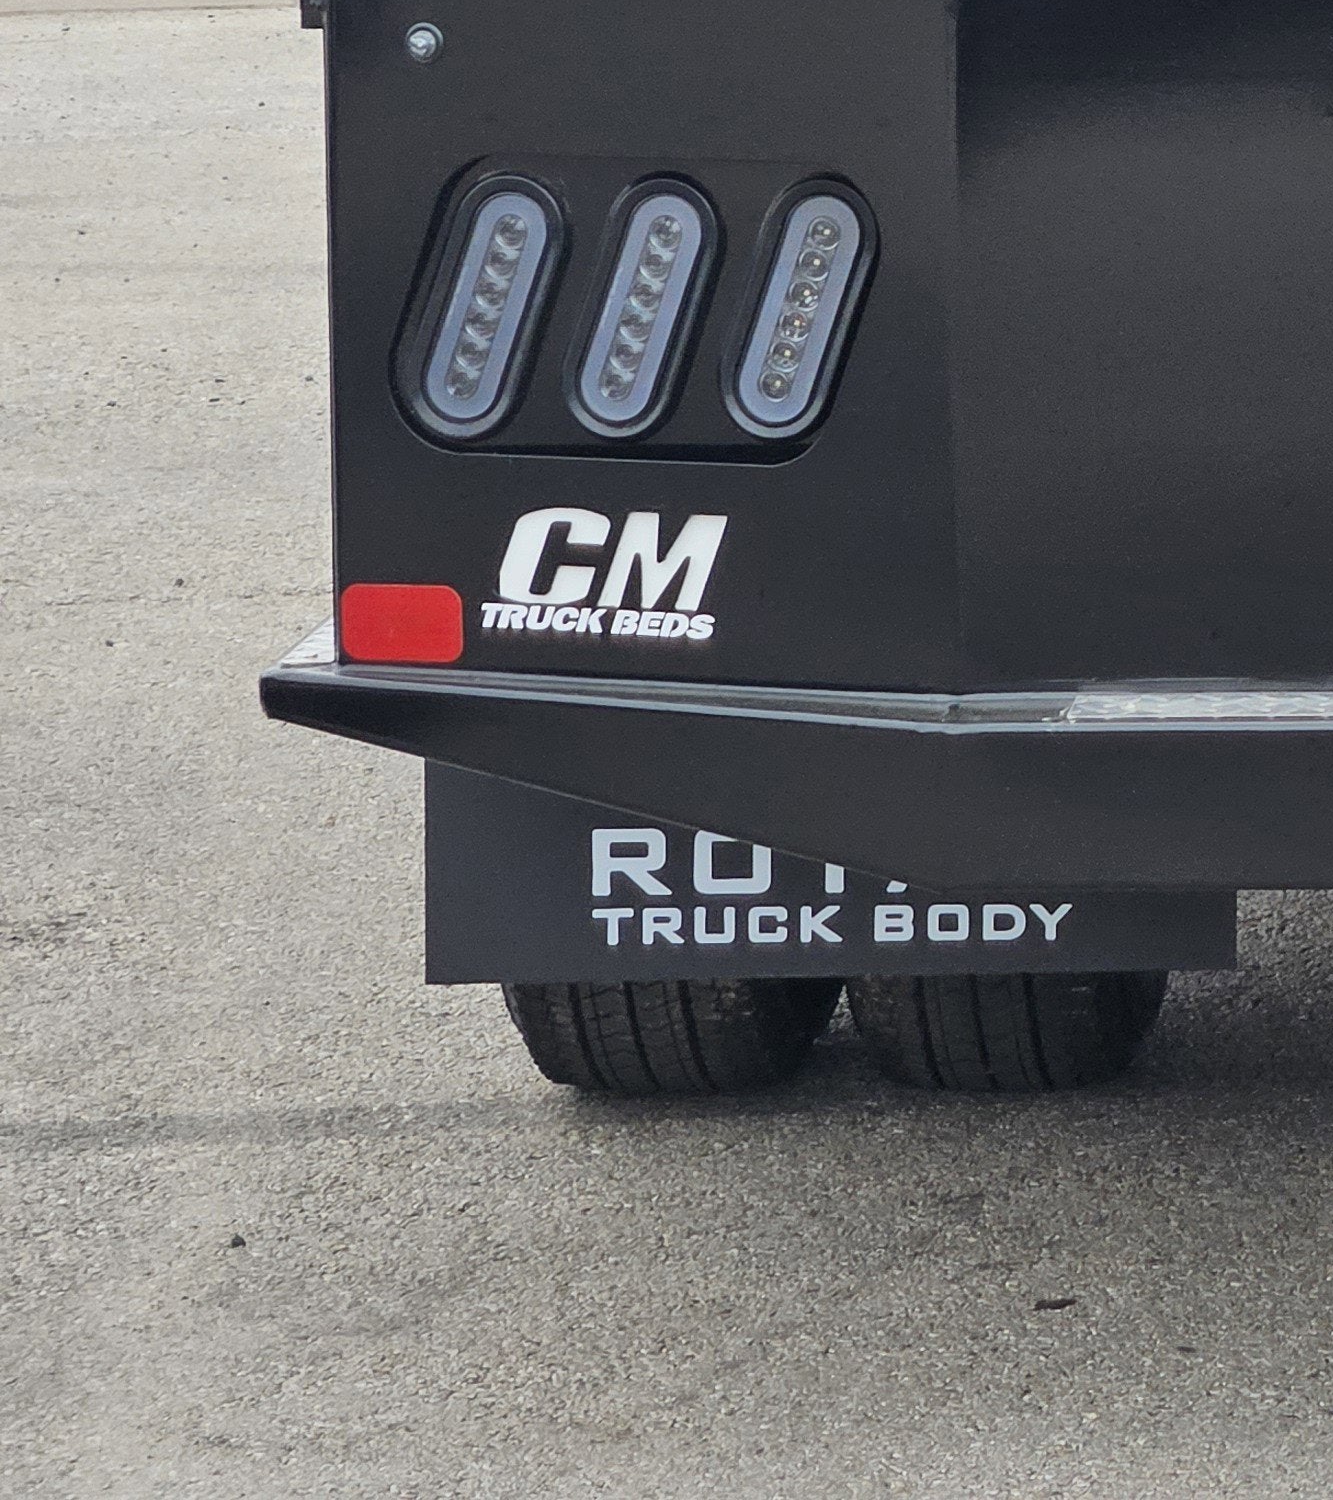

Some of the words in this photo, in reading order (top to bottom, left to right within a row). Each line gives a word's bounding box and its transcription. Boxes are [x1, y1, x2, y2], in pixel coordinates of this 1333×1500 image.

[499, 507, 728, 611] CM
[481, 602, 607, 634] TRUCK
[610, 609, 716, 639] BEDS
[592, 905, 843, 946] TRUCK
[873, 903, 1073, 942] BODY
